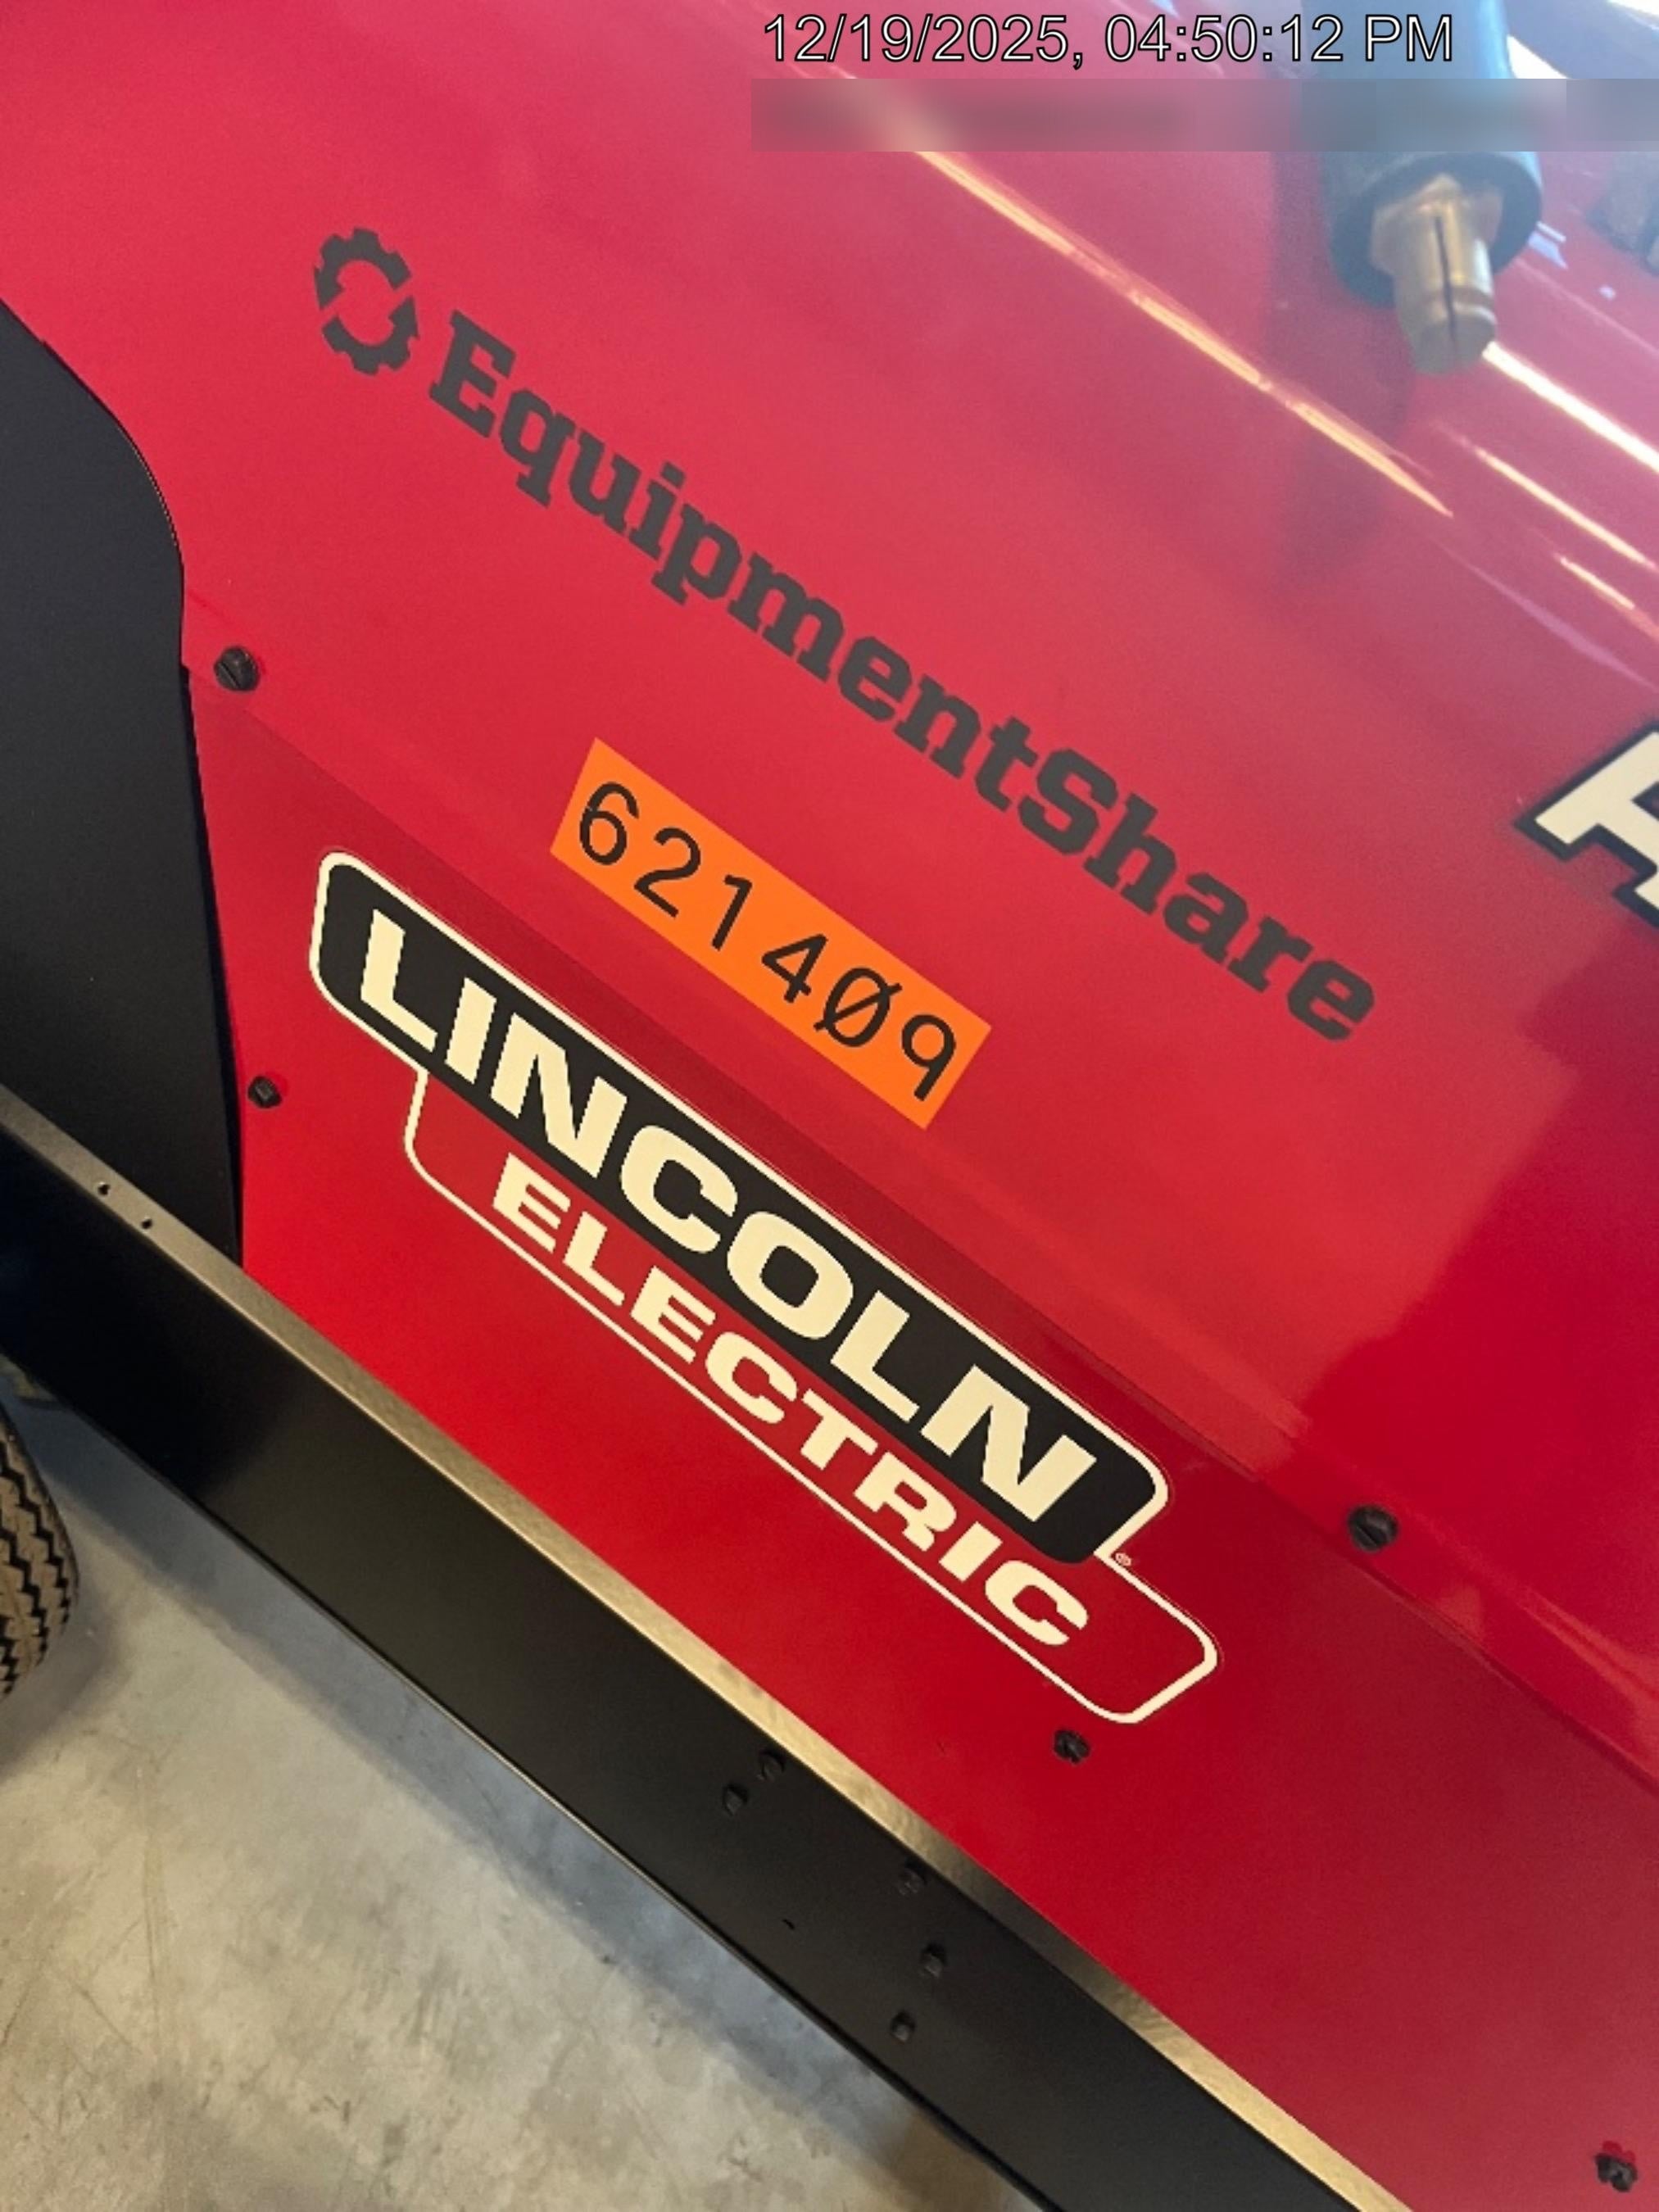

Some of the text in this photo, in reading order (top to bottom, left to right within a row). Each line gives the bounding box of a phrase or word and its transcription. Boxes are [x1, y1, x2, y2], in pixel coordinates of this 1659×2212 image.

[428, 308, 1376, 1041] EquipmentShare
[578, 781, 957, 1102] 621409
[360, 909, 1097, 1522] LINCOLN
[492, 1152, 1089, 1646] ELECTRIC
